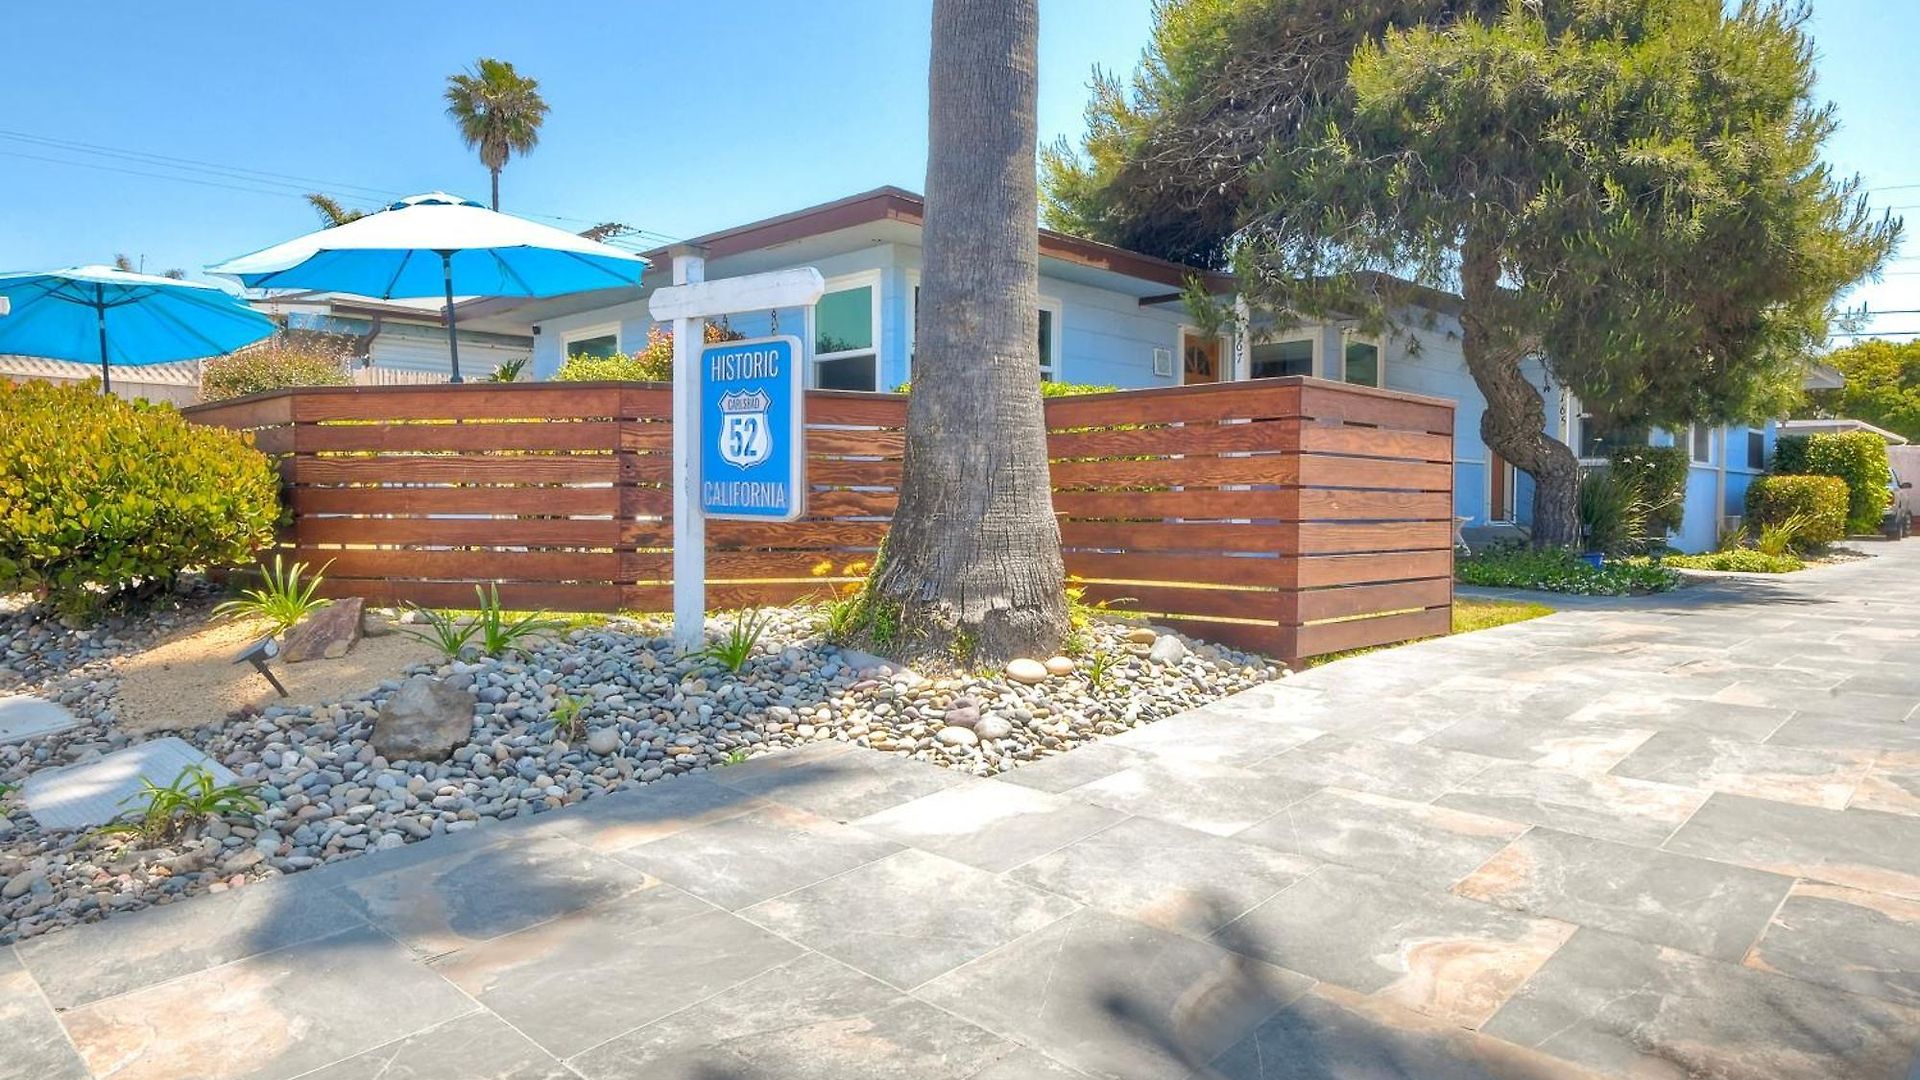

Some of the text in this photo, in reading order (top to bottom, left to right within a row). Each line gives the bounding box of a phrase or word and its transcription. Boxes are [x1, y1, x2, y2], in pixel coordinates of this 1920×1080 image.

[712, 350, 779, 382] HISTORIC
[727, 398, 760, 410] CARLSBAD
[730, 418, 757, 457] 52
[704, 481, 786, 508] CALIFORNIA
